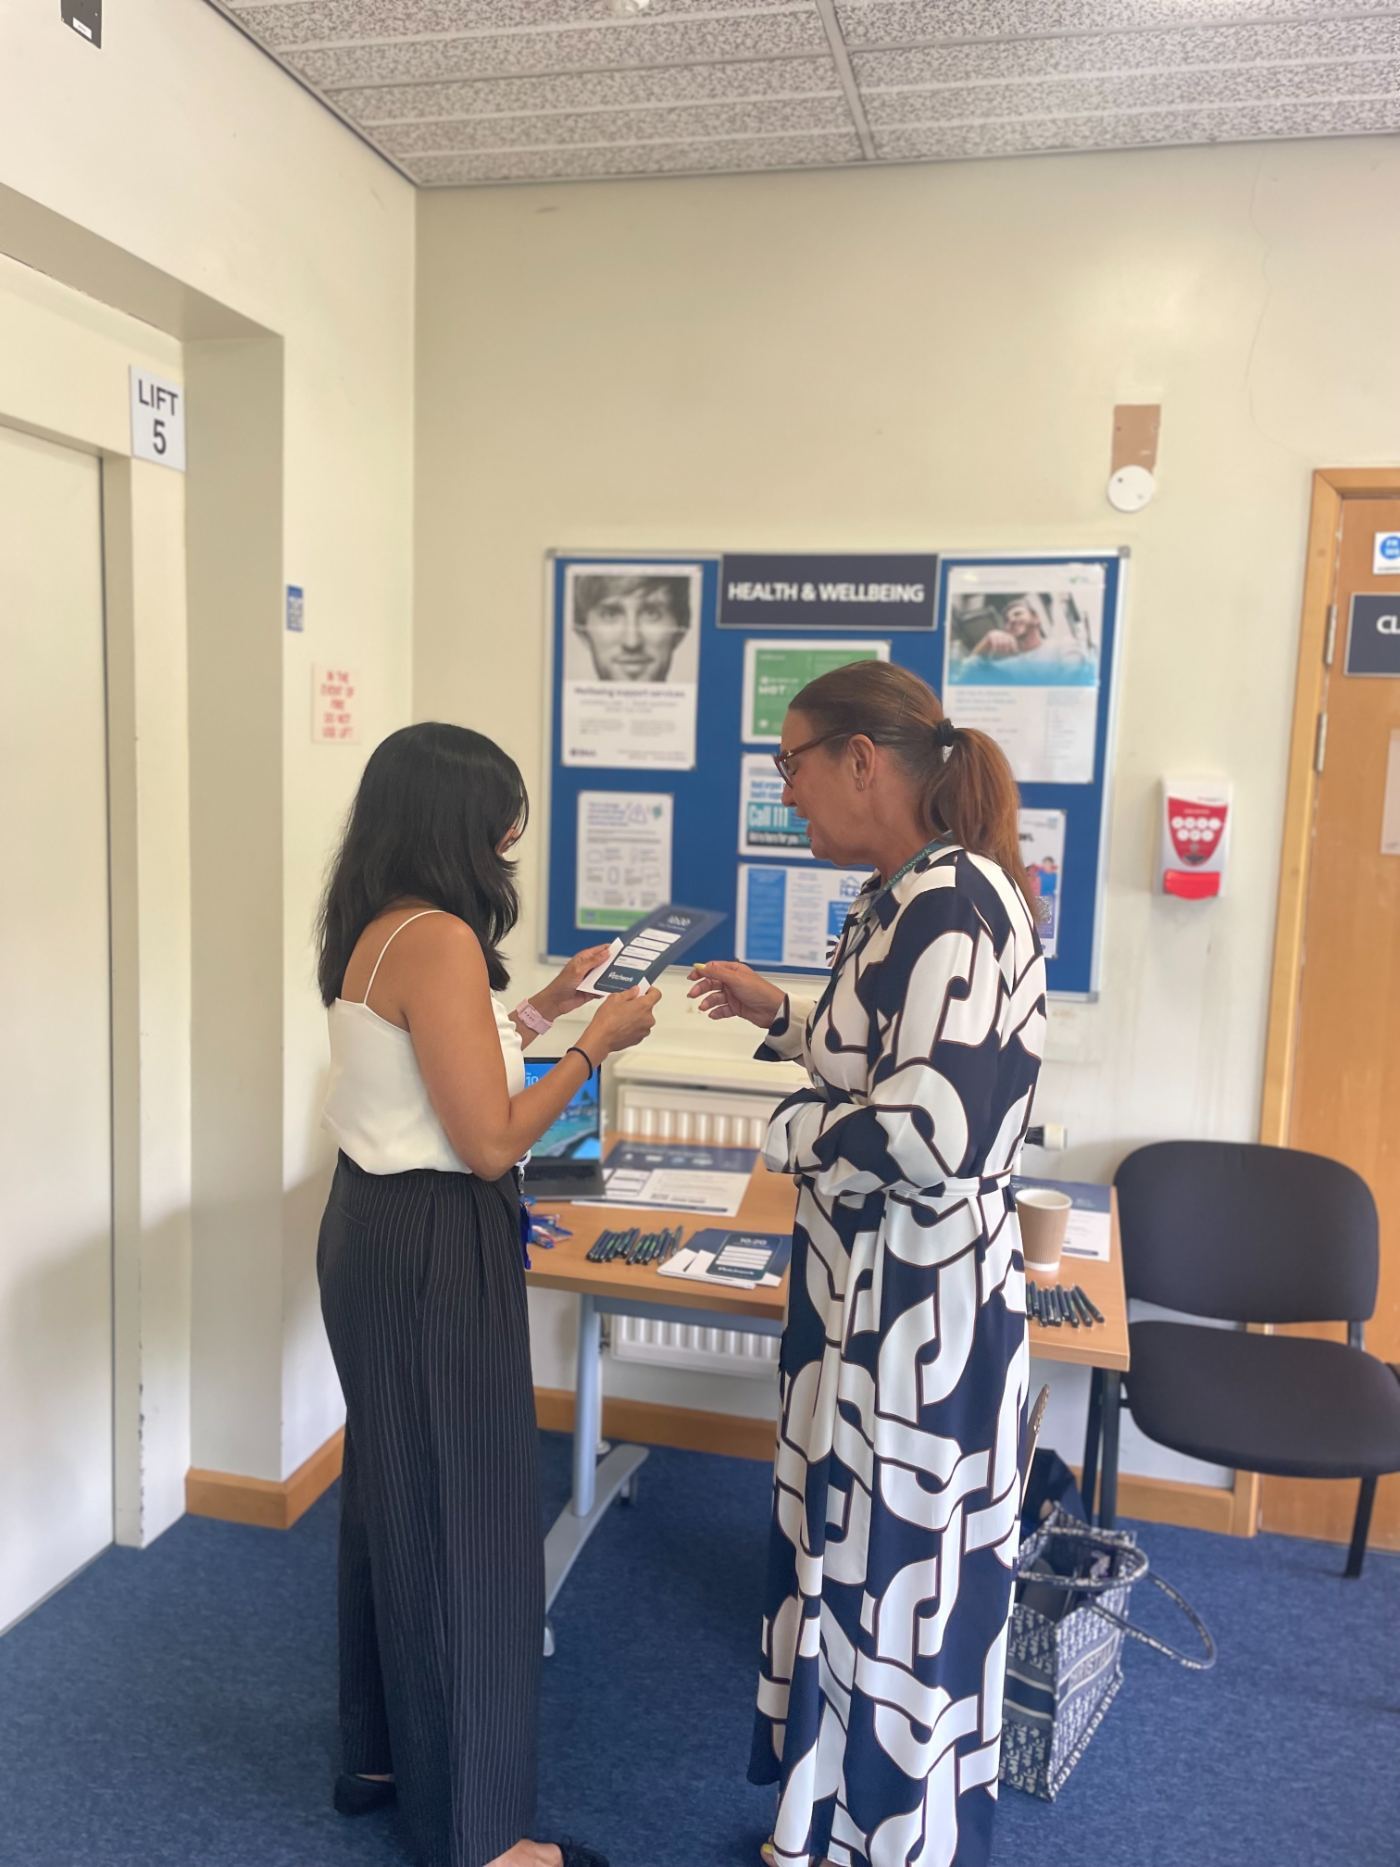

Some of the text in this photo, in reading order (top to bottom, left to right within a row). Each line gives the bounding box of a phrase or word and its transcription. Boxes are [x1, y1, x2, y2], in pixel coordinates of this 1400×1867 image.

[138, 378, 178, 416] LIFT
[153, 418, 166, 455] 5
[727, 582, 925, 603] HEALTH & WELLBEING
